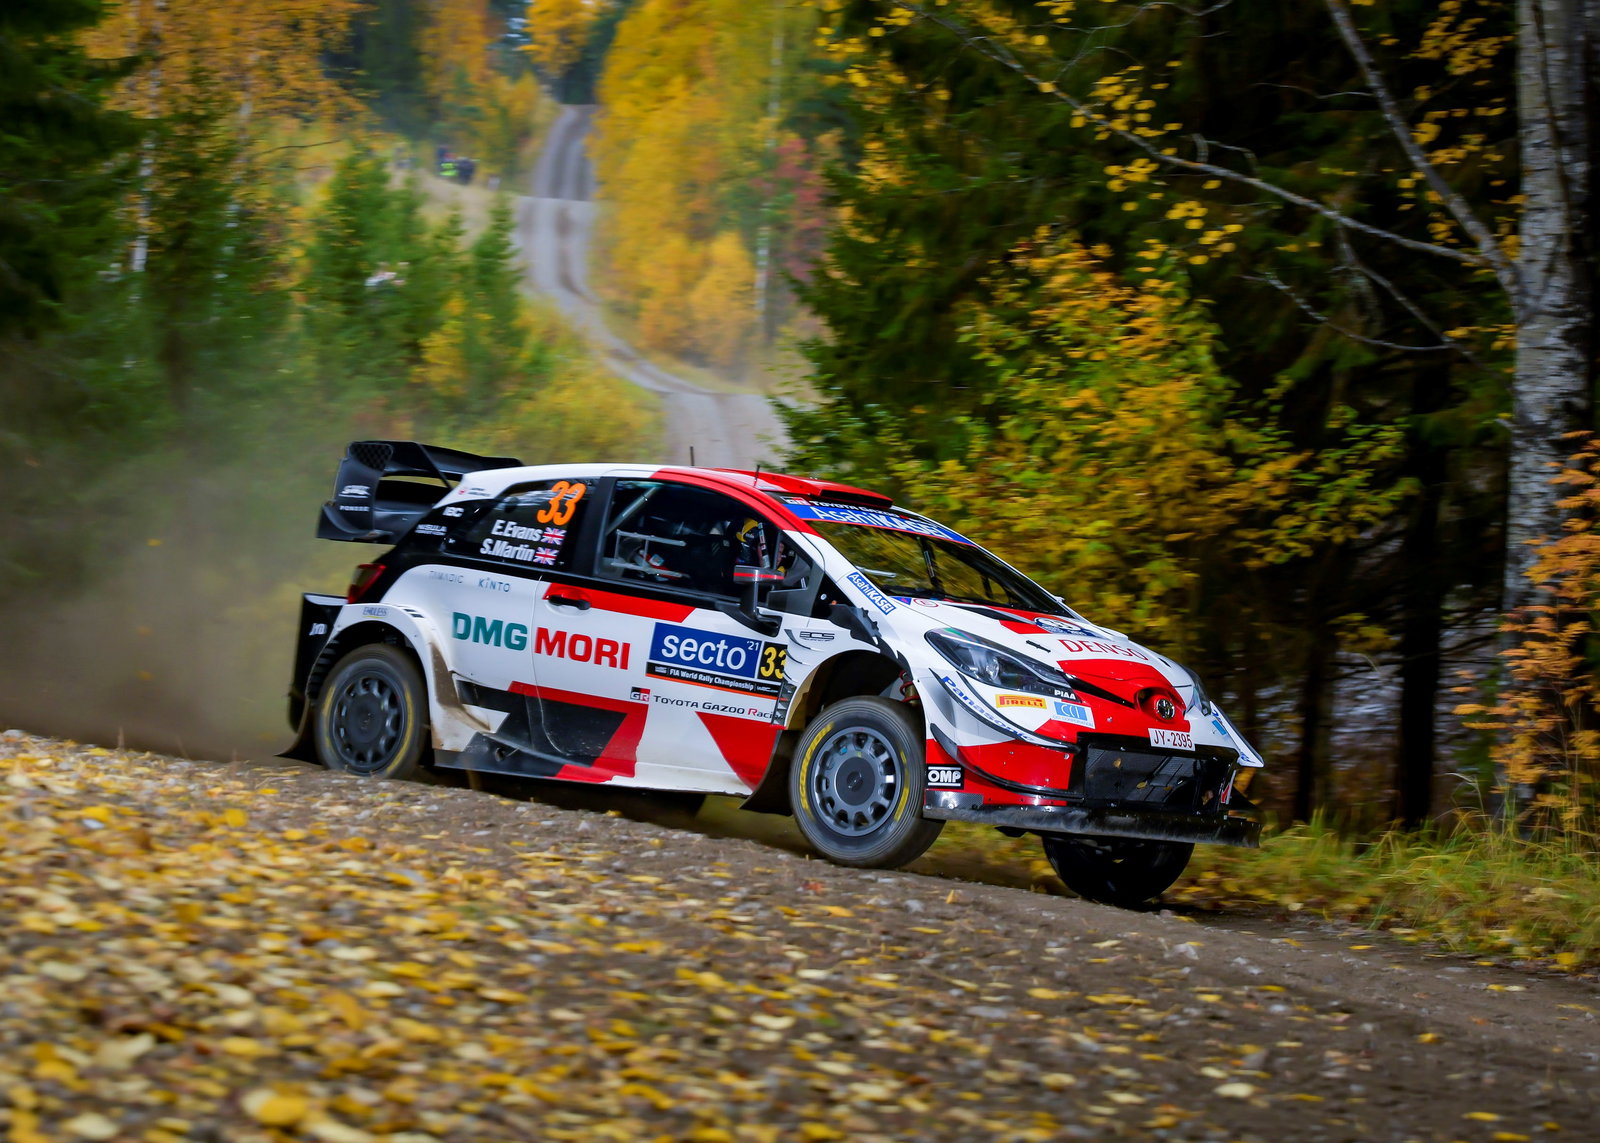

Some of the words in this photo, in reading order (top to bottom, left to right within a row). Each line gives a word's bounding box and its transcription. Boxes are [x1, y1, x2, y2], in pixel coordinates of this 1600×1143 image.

[537, 481, 586, 526] 33
[491, 520, 543, 542] E.Evans
[480, 538, 536, 562] S.Martin
[849, 574, 893, 613] AsahiKASEI
[452, 612, 528, 651] DMG
[534, 627, 631, 670] MORI
[661, 635, 746, 670] secto
[1057, 639, 1149, 661] DENSO
[669, 668, 680, 677] FIA
[680, 671, 699, 680] World
[699, 675, 714, 684] Rally
[714, 678, 755, 692] Championship
[630, 691, 650, 701] GR
[653, 695, 699, 709] TOYOTA
[702, 702, 745, 715] GAZOO
[999, 695, 1043, 708] PIRELLI
[1054, 689, 1077, 700] PIAA
[928, 770, 961, 783] OMP
